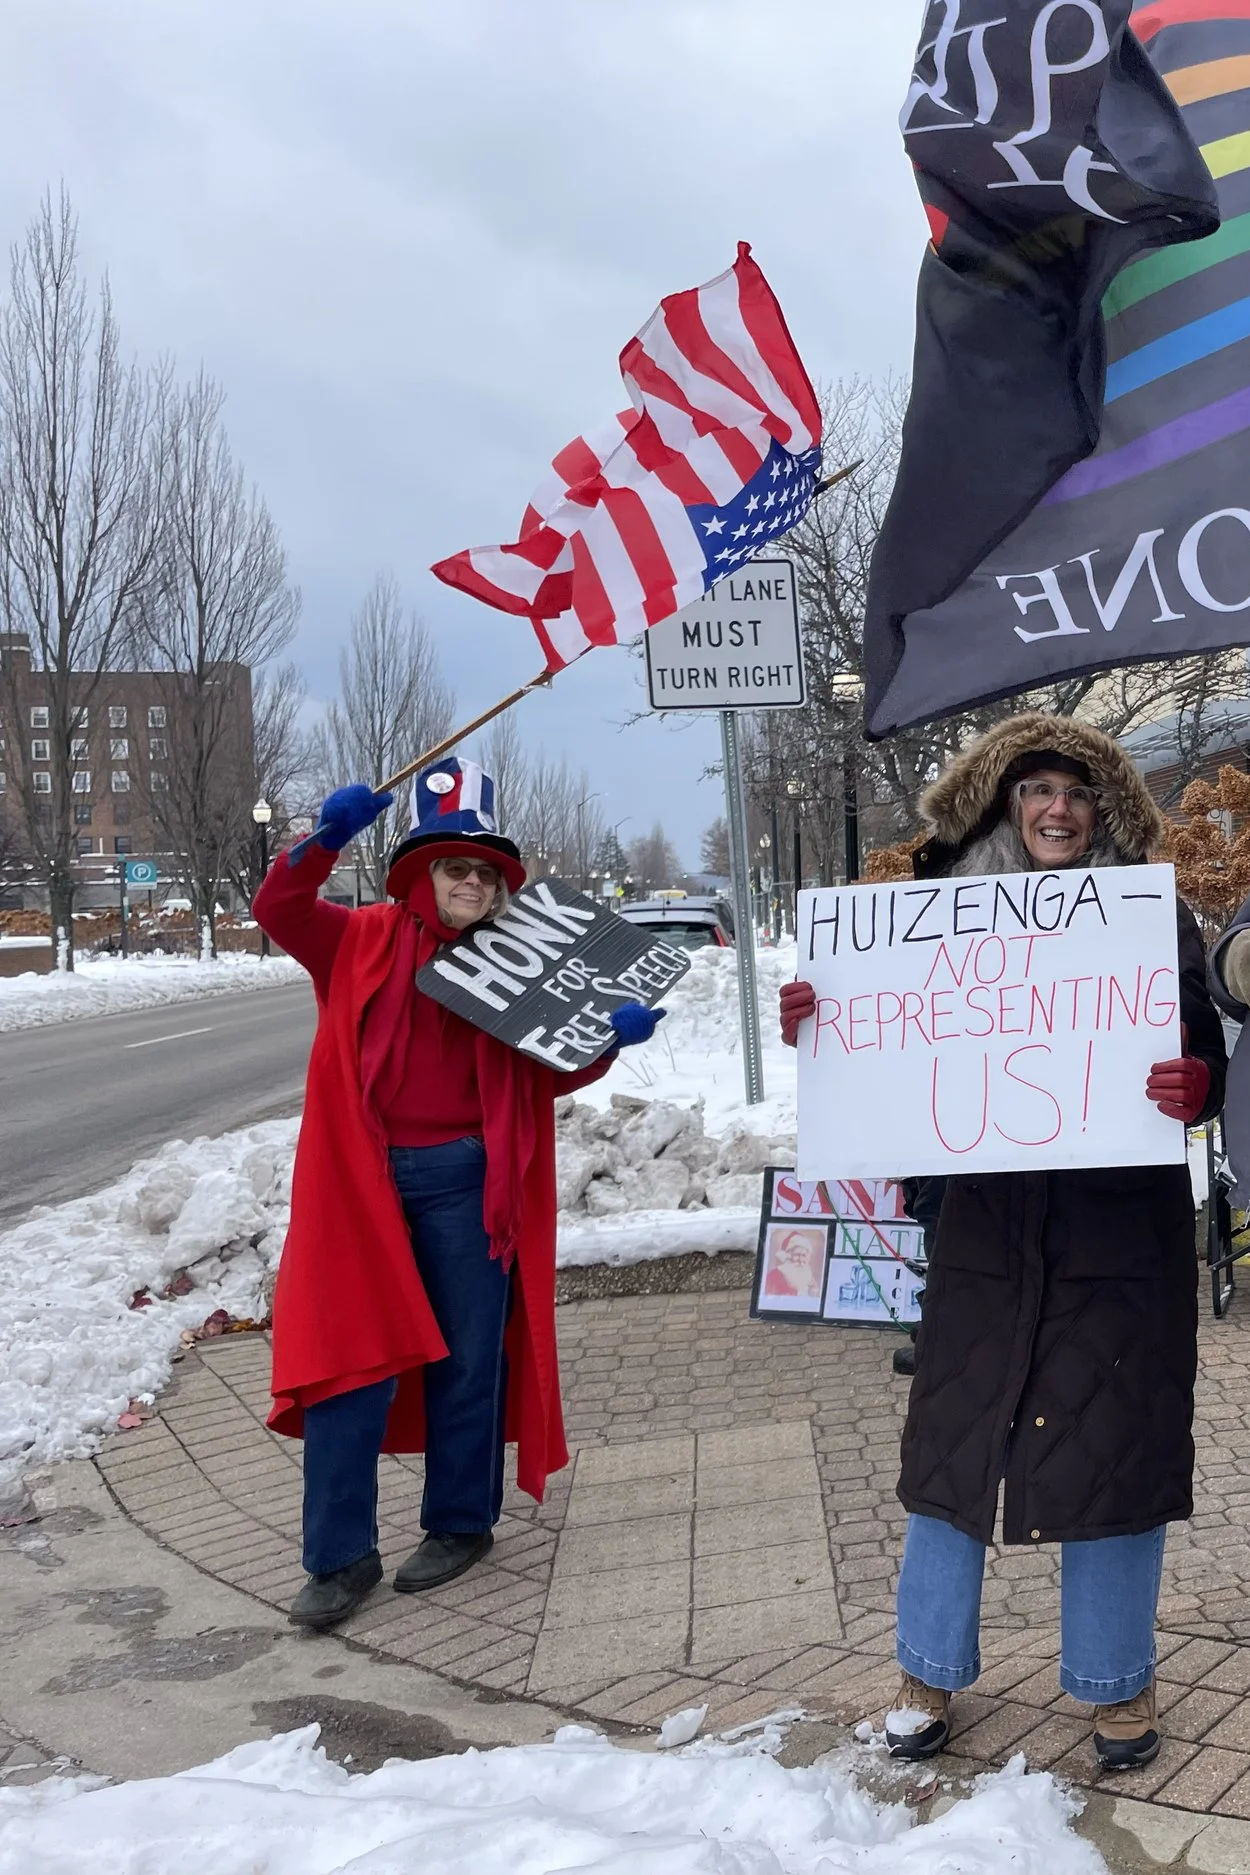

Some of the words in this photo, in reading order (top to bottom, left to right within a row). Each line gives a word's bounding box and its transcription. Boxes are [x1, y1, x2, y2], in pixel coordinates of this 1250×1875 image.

[730, 579, 787, 601] LANE
[682, 620, 762, 648] MUST
[656, 667, 717, 690] TURN
[727, 664, 794, 688] RIGHT
[809, 874, 1108, 961] HUIZENGA
[433, 882, 596, 1012] HONK
[924, 933, 1063, 990] NOT
[517, 1001, 617, 1072] FREE
[591, 941, 691, 1006] SPEECH
[542, 956, 600, 1003] FOR
[813, 965, 1177, 1058] REPRESENTING
[932, 1040, 1093, 1153] US!
[775, 1177, 908, 1219] SANT
